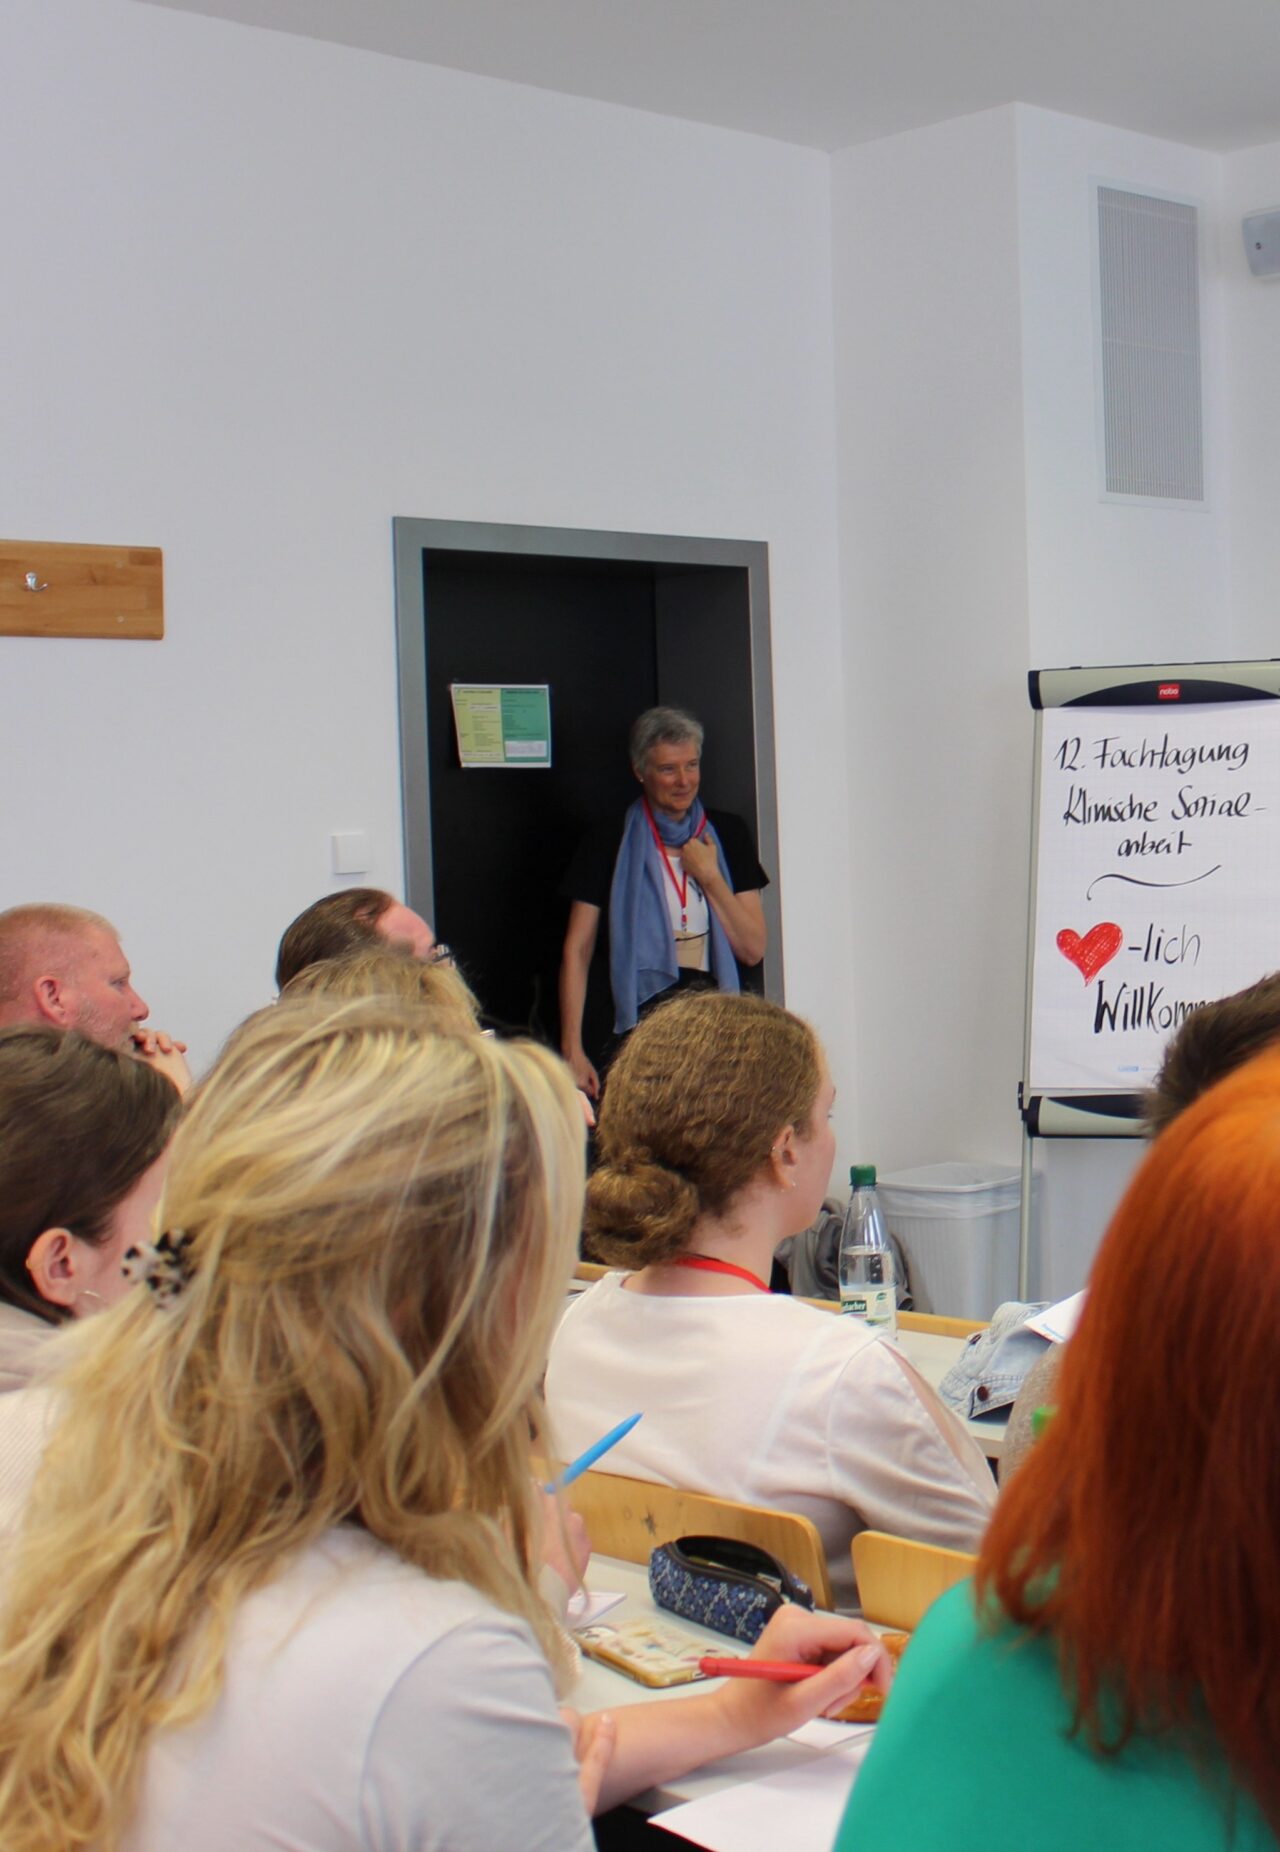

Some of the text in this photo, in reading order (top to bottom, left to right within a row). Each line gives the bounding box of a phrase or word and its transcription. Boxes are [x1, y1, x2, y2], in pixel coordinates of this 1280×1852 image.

[1054, 733, 1250, 774] 12. Fachtagung
[1063, 784, 1160, 826] Klinische
[1117, 830, 1193, 857] arbeit
